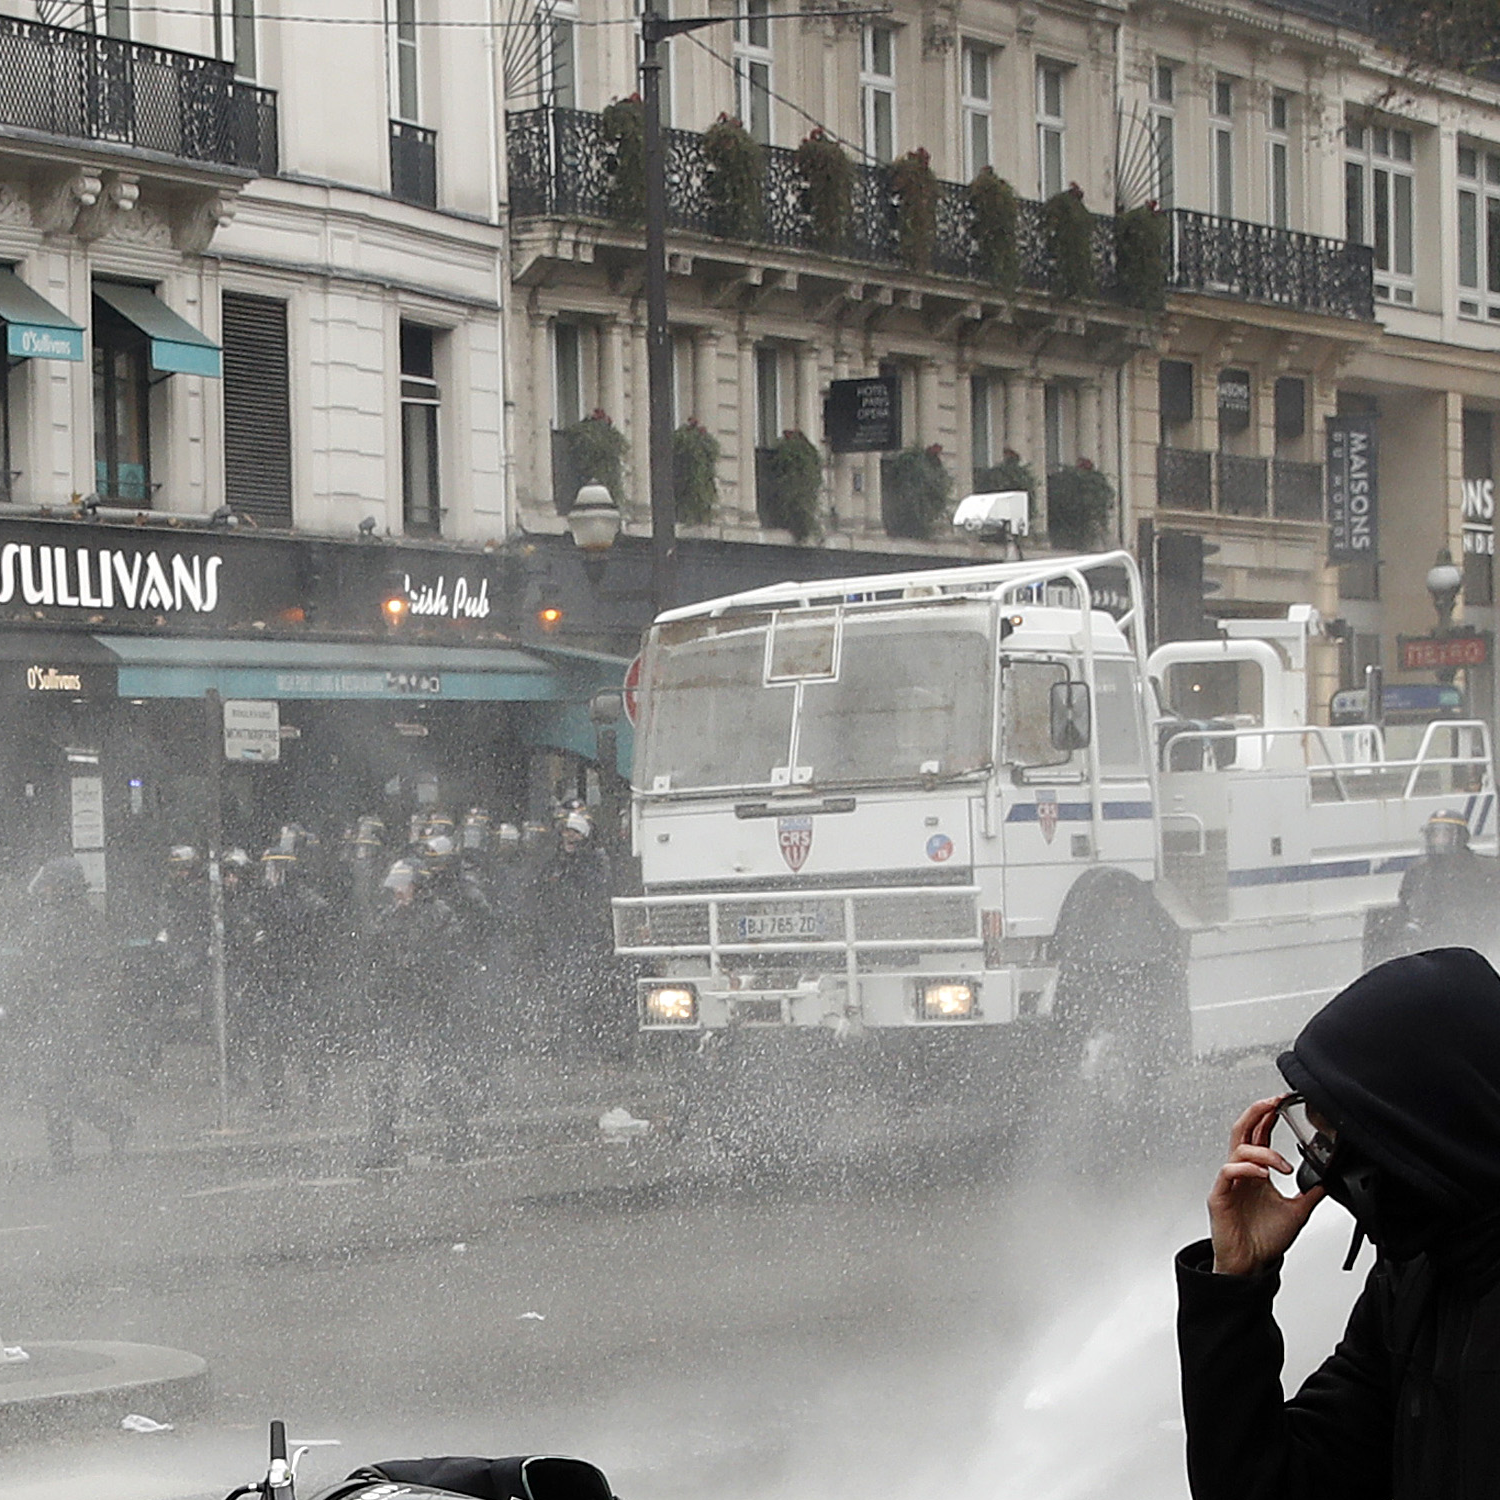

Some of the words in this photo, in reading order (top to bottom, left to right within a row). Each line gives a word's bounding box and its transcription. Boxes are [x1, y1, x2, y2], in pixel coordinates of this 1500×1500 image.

[1350, 431, 1370, 549] MAISONS
[452, 577, 490, 619] Pub
[780, 831, 810, 847] CRS
